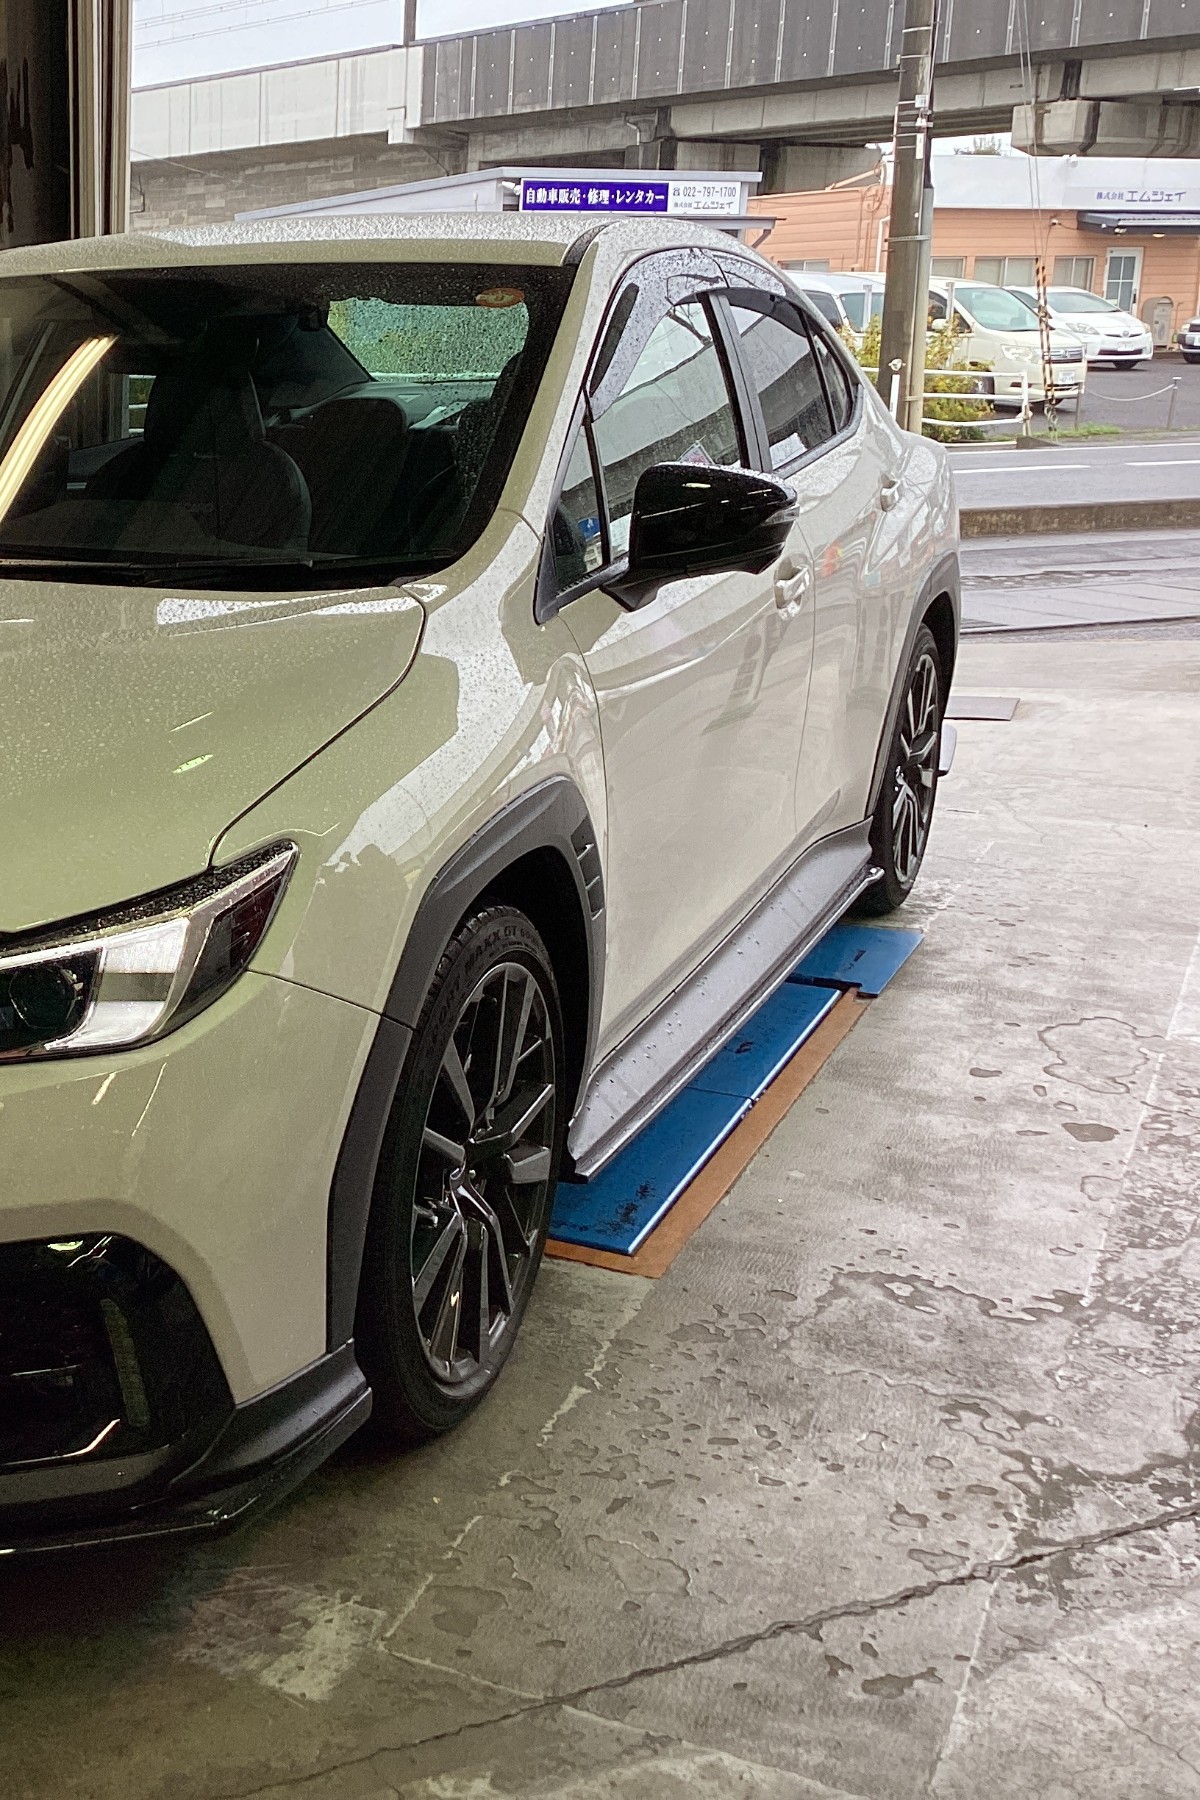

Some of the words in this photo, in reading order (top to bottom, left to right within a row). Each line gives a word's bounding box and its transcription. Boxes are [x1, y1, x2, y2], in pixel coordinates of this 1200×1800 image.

[525, 187, 666, 205] 自動車販売・修理・レンタカー
[682, 186, 737, 198] 022-797-1700
